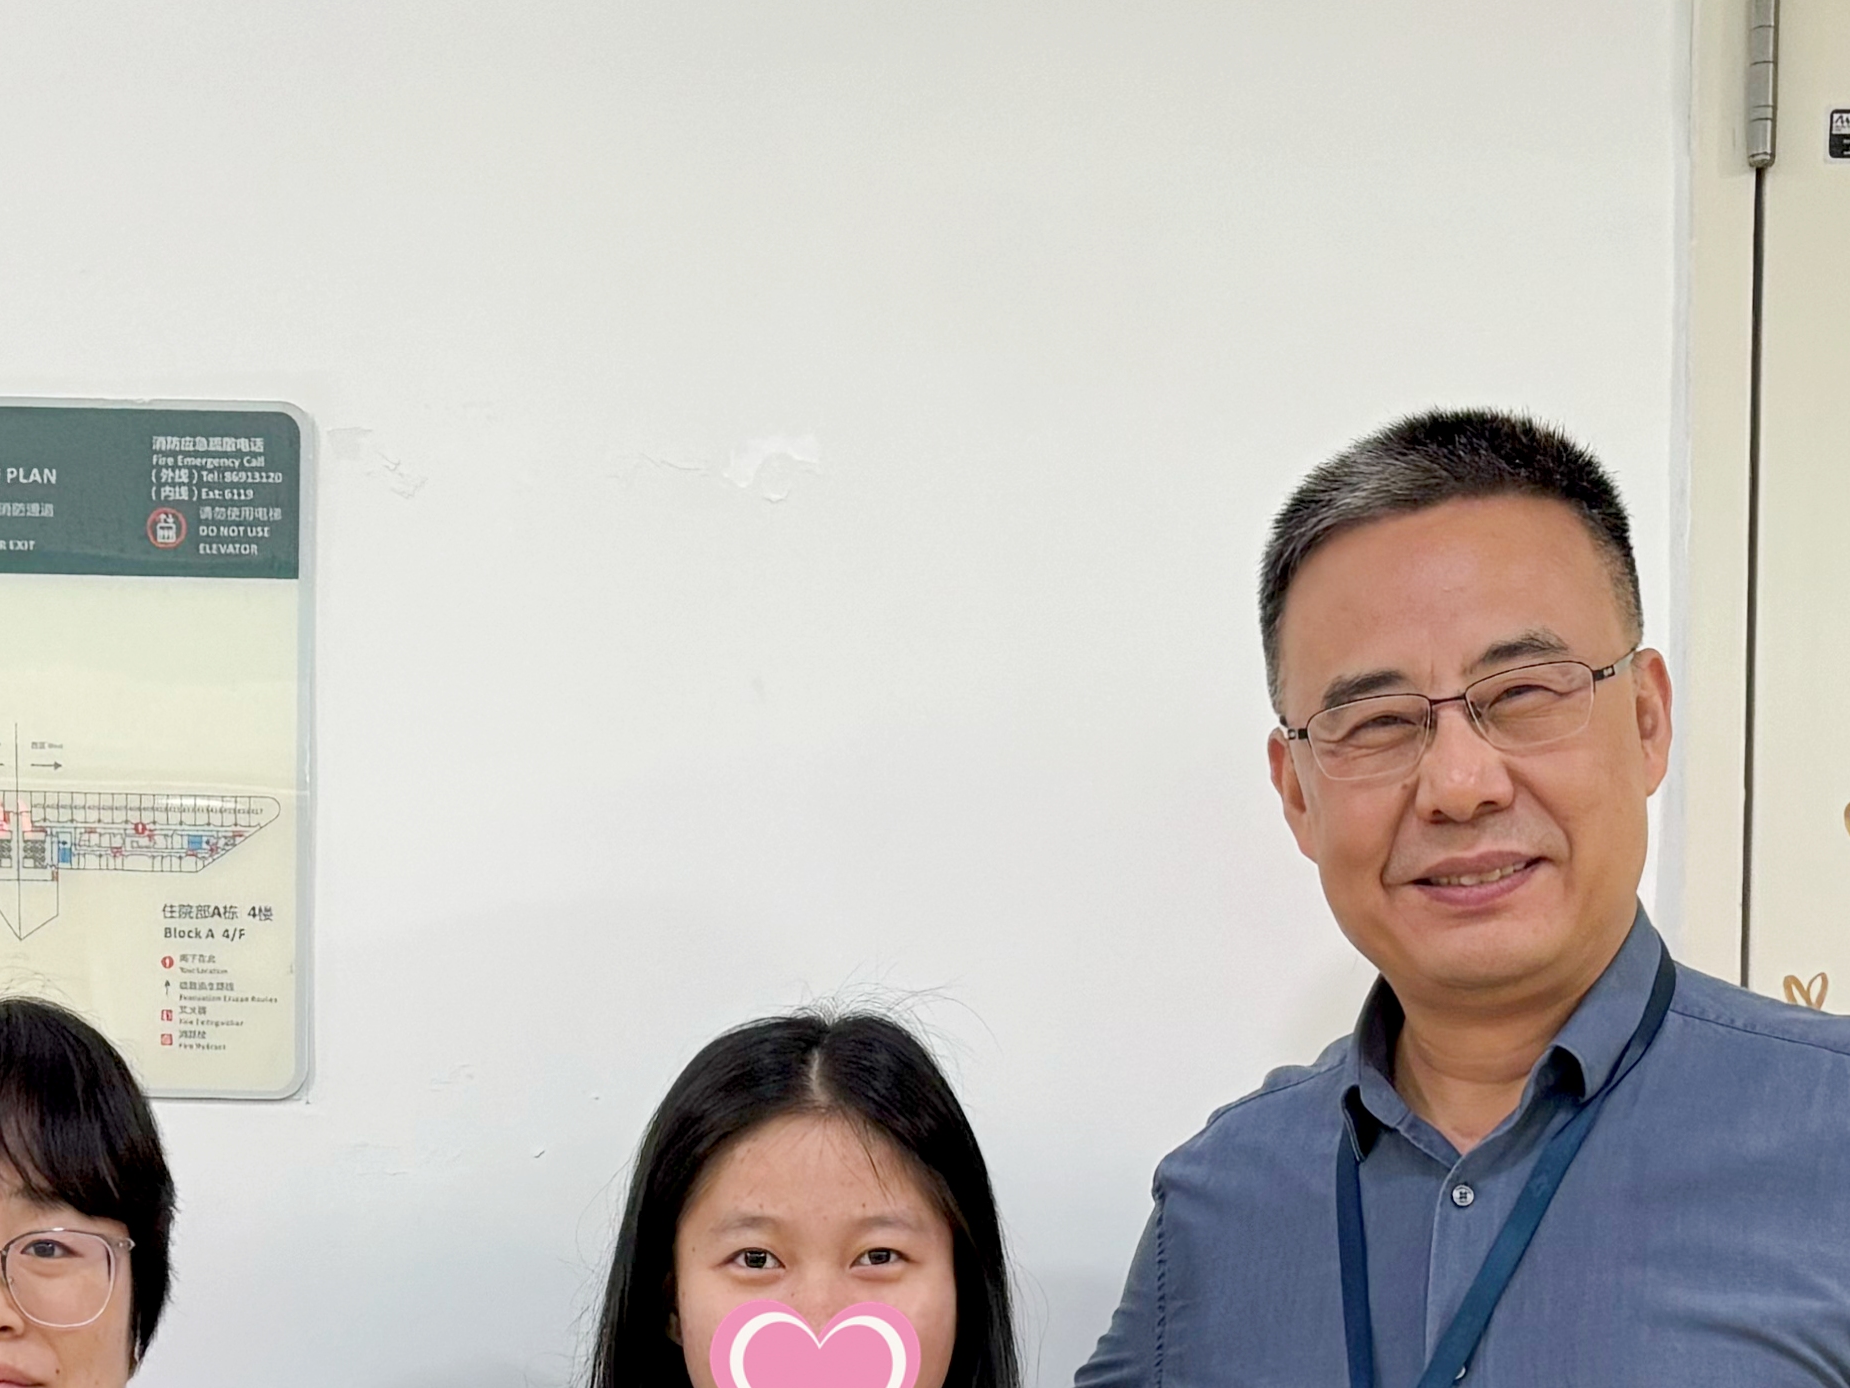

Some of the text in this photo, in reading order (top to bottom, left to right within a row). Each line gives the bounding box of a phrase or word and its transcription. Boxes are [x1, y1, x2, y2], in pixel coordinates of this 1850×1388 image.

[152, 454, 265, 469] Fire Emergency Call
[6, 468, 57, 485] PLAN
[199, 526, 269, 537] DO NOT USE
[9, 540, 35, 551] EXIT
[199, 543, 258, 555] ELEVATOR
[164, 927, 246, 942] Block A 4/F
